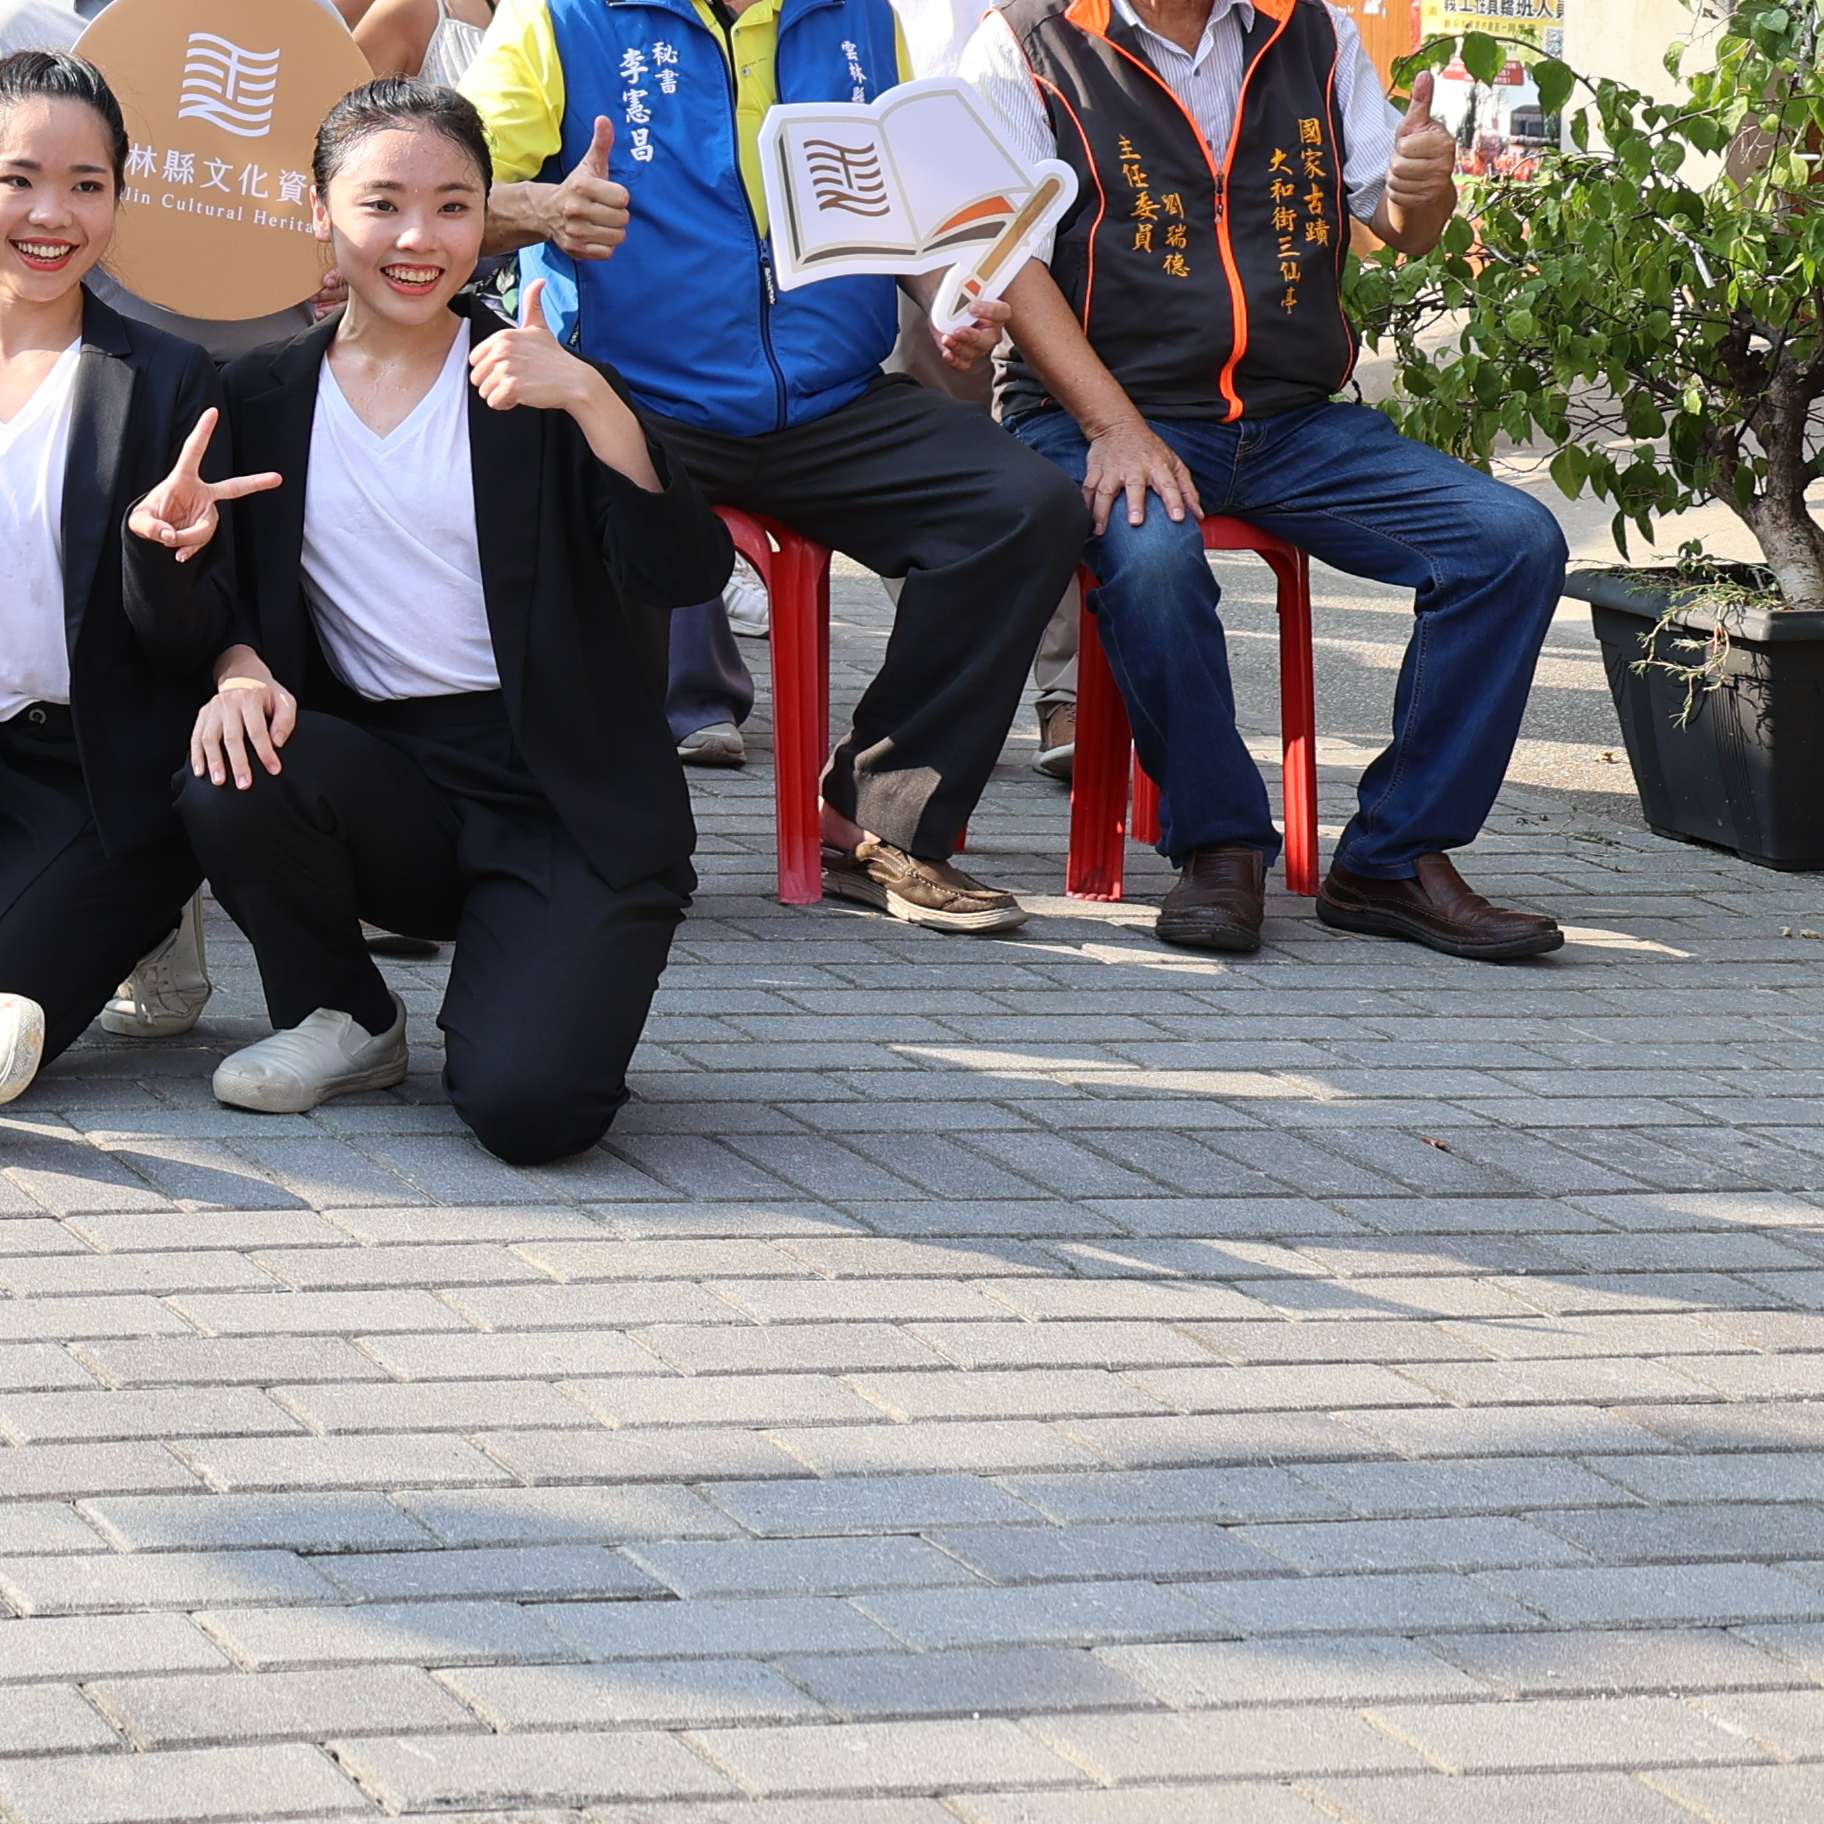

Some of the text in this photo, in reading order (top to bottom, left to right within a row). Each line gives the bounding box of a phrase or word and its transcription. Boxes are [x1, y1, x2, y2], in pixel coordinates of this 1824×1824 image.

[619, 47, 655, 163] 李憲昌
[651, 40, 679, 95] 秘書
[122, 142, 310, 207] 林縣文化資
[161, 191, 243, 223] Cultural
[253, 208, 314, 235] Herita
[1118, 135, 1154, 253] 主任委員
[1297, 117, 1329, 247] 國家古蹟
[1161, 192, 1190, 278] 劉瑞德
